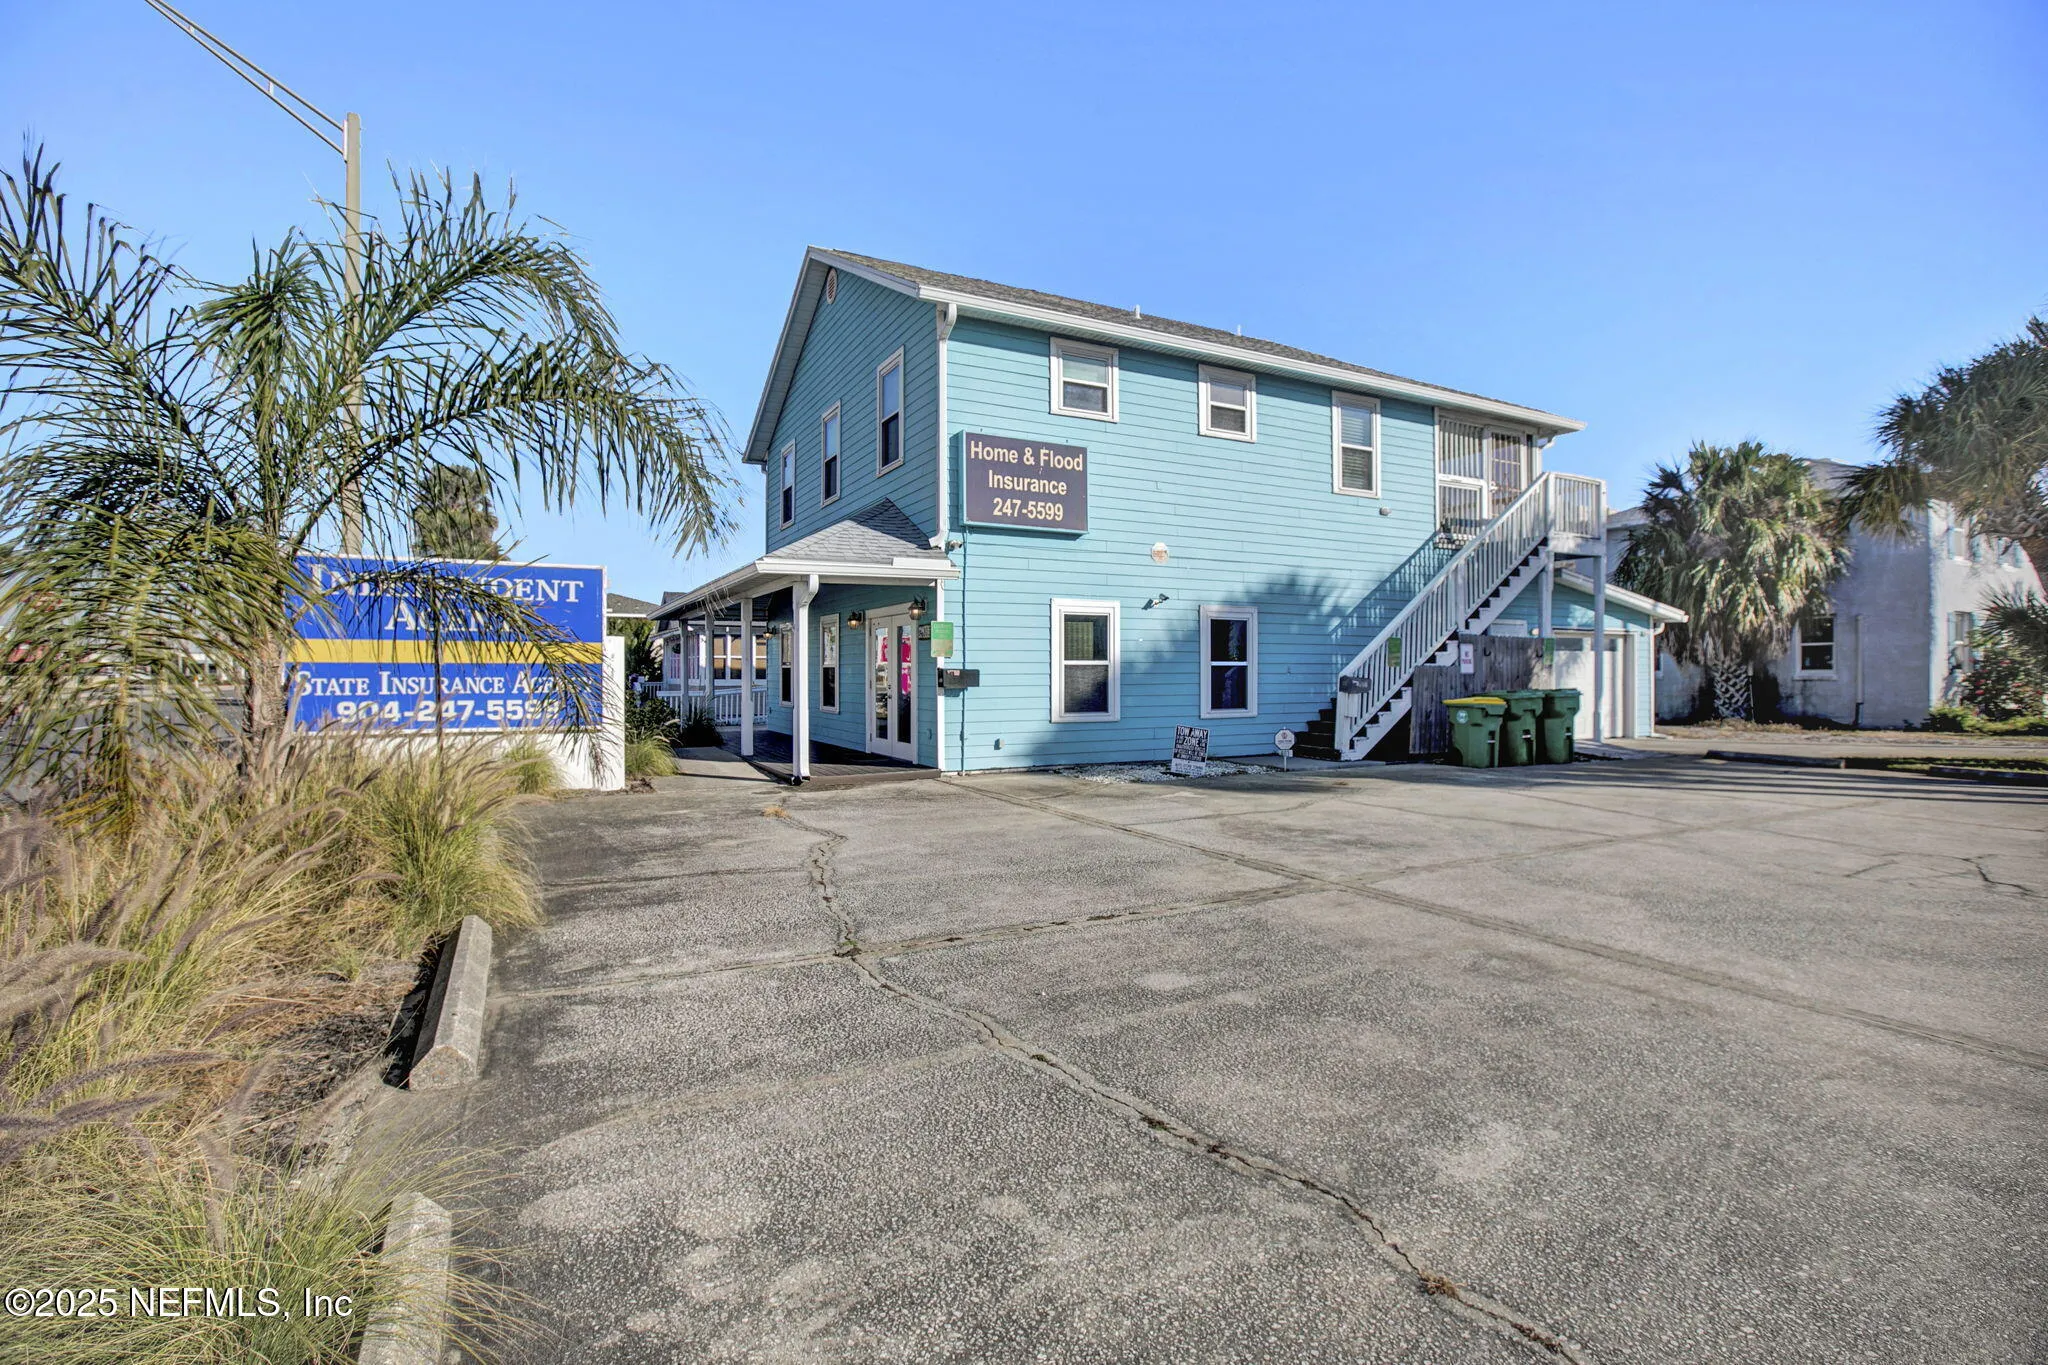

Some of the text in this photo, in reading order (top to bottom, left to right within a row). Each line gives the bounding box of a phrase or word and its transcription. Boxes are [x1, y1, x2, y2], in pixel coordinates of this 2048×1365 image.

[970, 440, 1083, 472] Home & Flood
[988, 469, 1067, 496] Insurance
[993, 497, 1063, 521] 247-5599
[294, 670, 592, 697] STATE INSURANCE AGE
[1177, 726, 1208, 739] TOW AWAY
